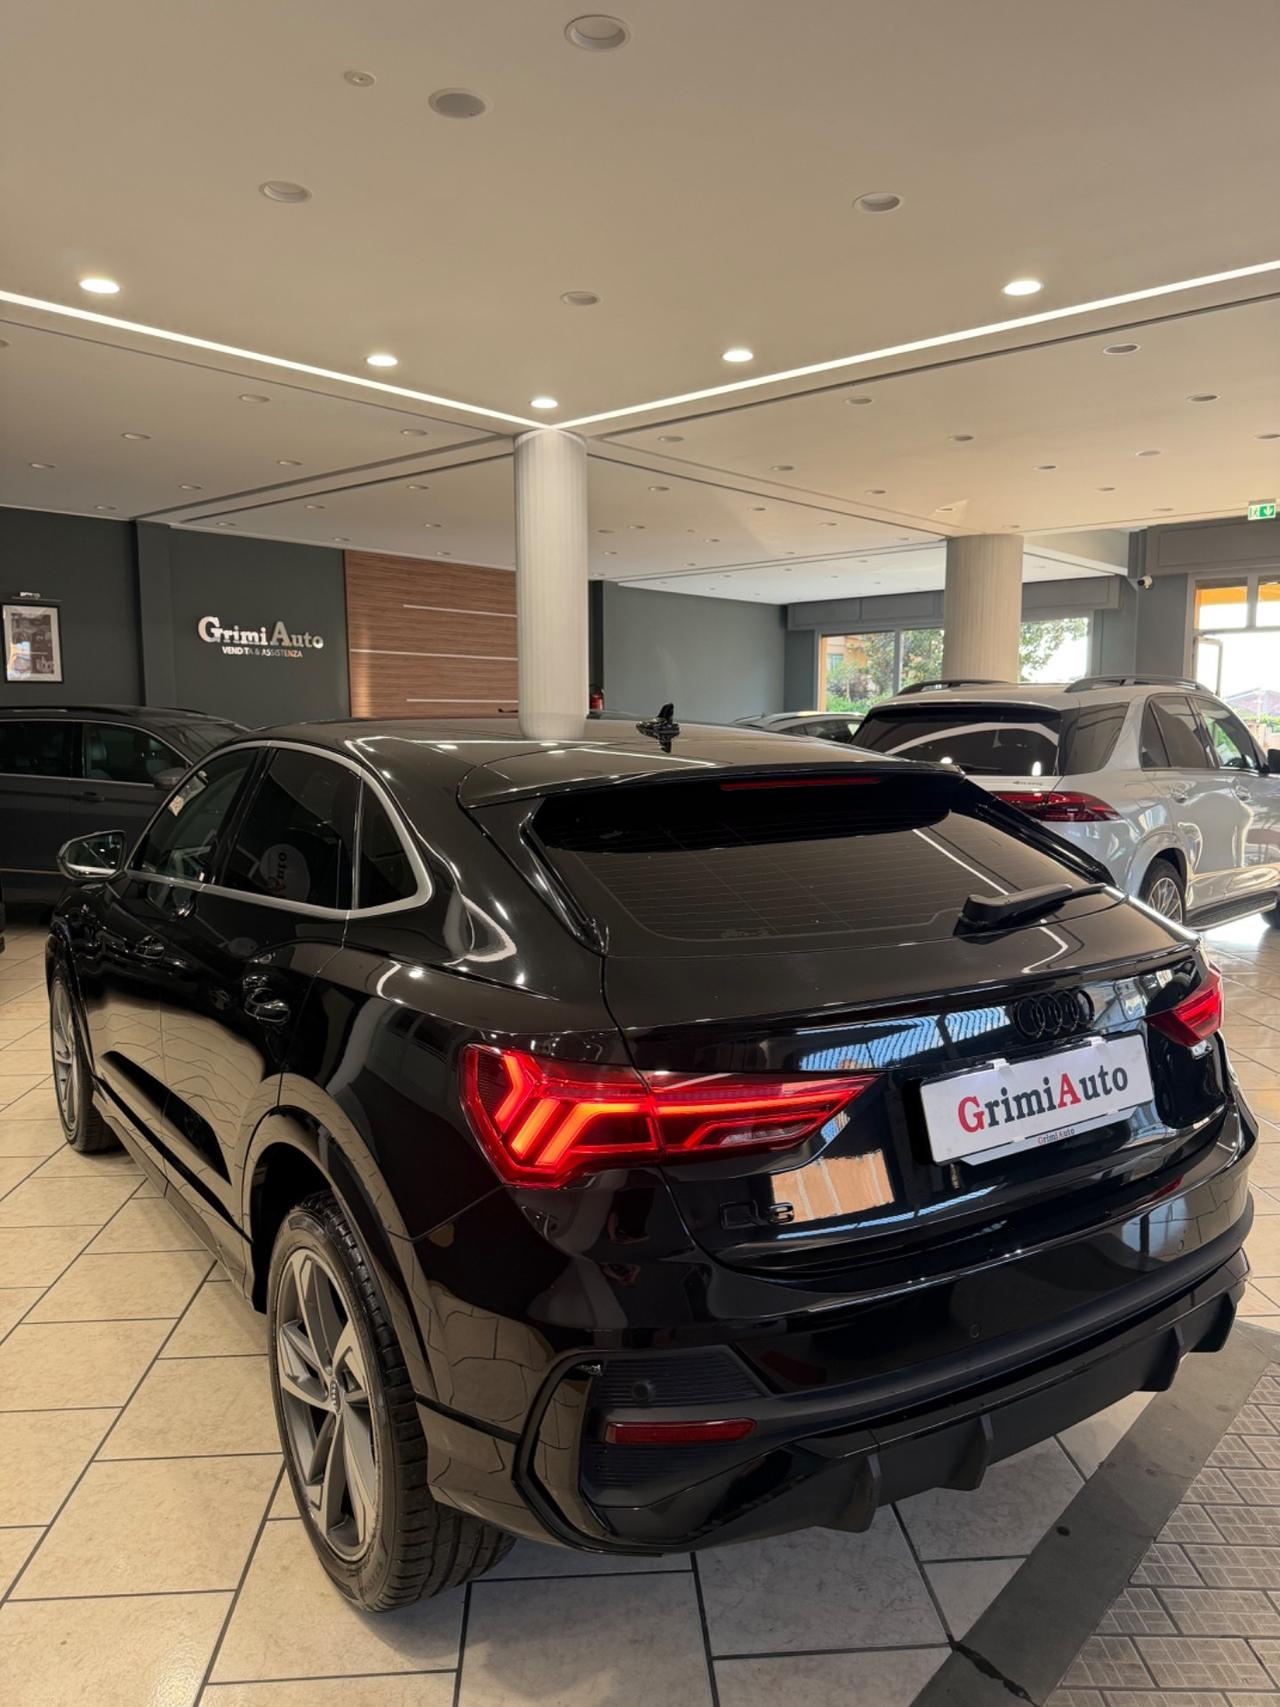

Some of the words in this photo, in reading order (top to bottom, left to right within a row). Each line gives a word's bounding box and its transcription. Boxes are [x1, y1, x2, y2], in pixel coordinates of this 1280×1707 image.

[222, 646, 253, 656] VENDTA
[957, 1065, 1128, 1133] GrimiAuto
[720, 1200, 795, 1230] Q3
